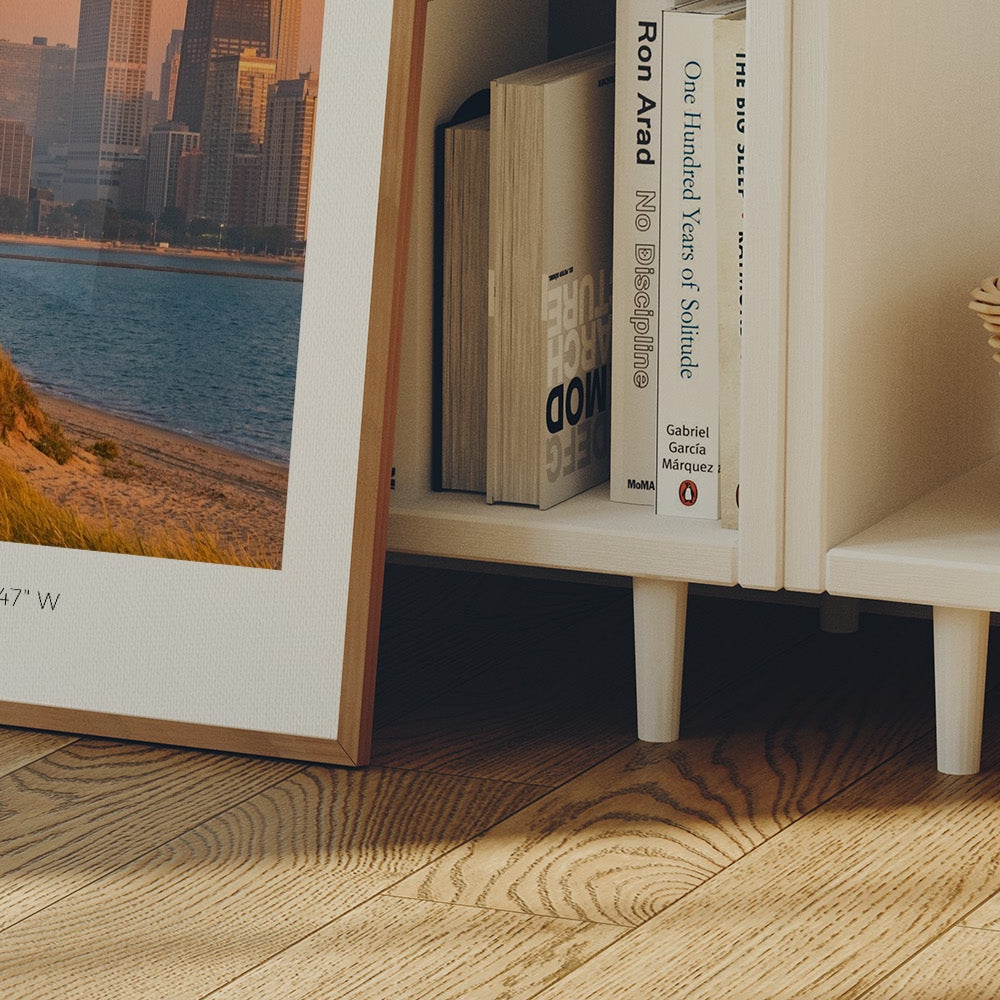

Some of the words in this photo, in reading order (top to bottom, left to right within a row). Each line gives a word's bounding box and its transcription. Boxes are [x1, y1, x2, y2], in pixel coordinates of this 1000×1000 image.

[637, 20, 657, 81] Ron
[683, 60, 702, 105] One
[636, 92, 657, 165] Arad
[682, 112, 702, 201] Hundred
[634, 190, 656, 232] No
[681, 207, 701, 261] Years
[681, 267, 700, 292] of
[630, 243, 655, 389] Discipline
[680, 298, 700, 379] Solitude
[666, 423, 710, 439] Gabriel
[668, 441, 707, 456] García
[627, 478, 656, 491] MoMA
[661, 457, 714, 474] Márquez
[37, 590, 61, 612] W
